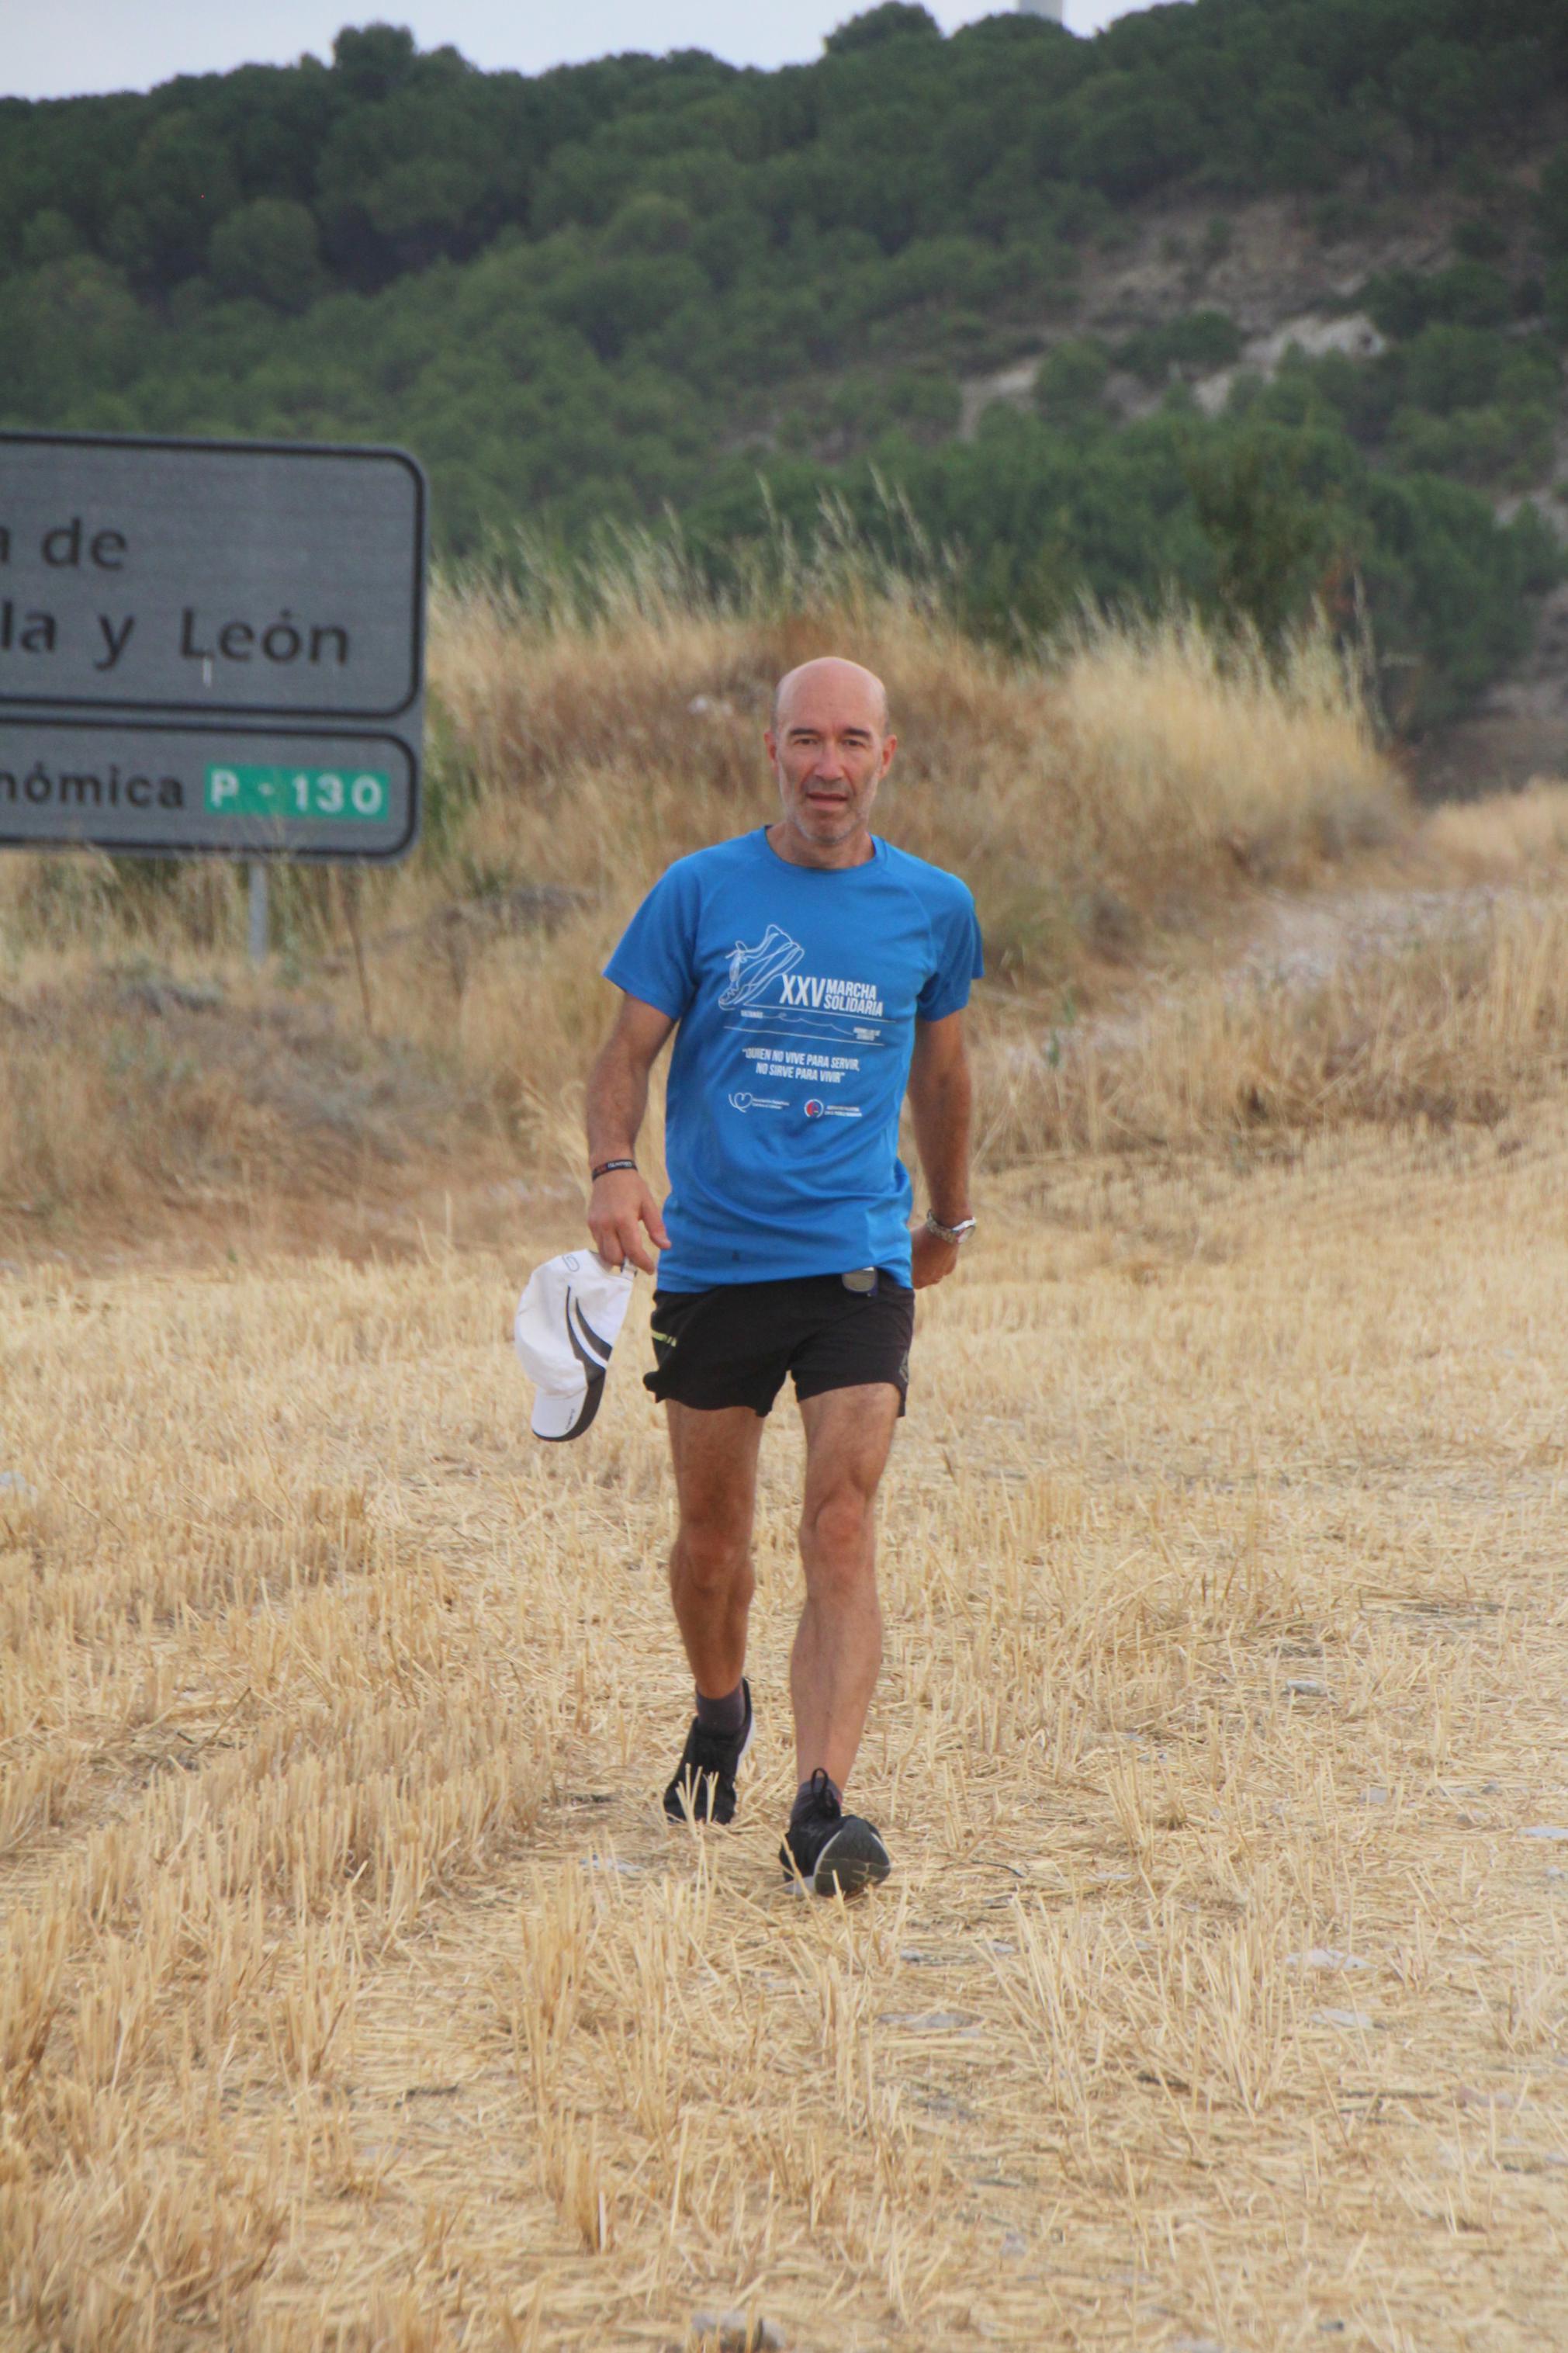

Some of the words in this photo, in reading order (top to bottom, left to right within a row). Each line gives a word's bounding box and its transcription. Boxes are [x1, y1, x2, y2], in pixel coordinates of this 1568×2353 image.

[41, 516, 127, 571] de
[94, 613, 135, 672] y
[181, 606, 349, 667] León
[779, 974, 826, 1007] XXV
[826, 979, 877, 1000] MARCHA
[823, 994, 883, 1017] SOLIDARIA
[756, 1062, 768, 1075] NO
[769, 1063, 794, 1079] SIRVE
[795, 1067, 819, 1081] PARA
[772, 1050, 784, 1062] NO
[785, 1051, 805, 1066] VIVE
[806, 1052, 829, 1069] PARA
